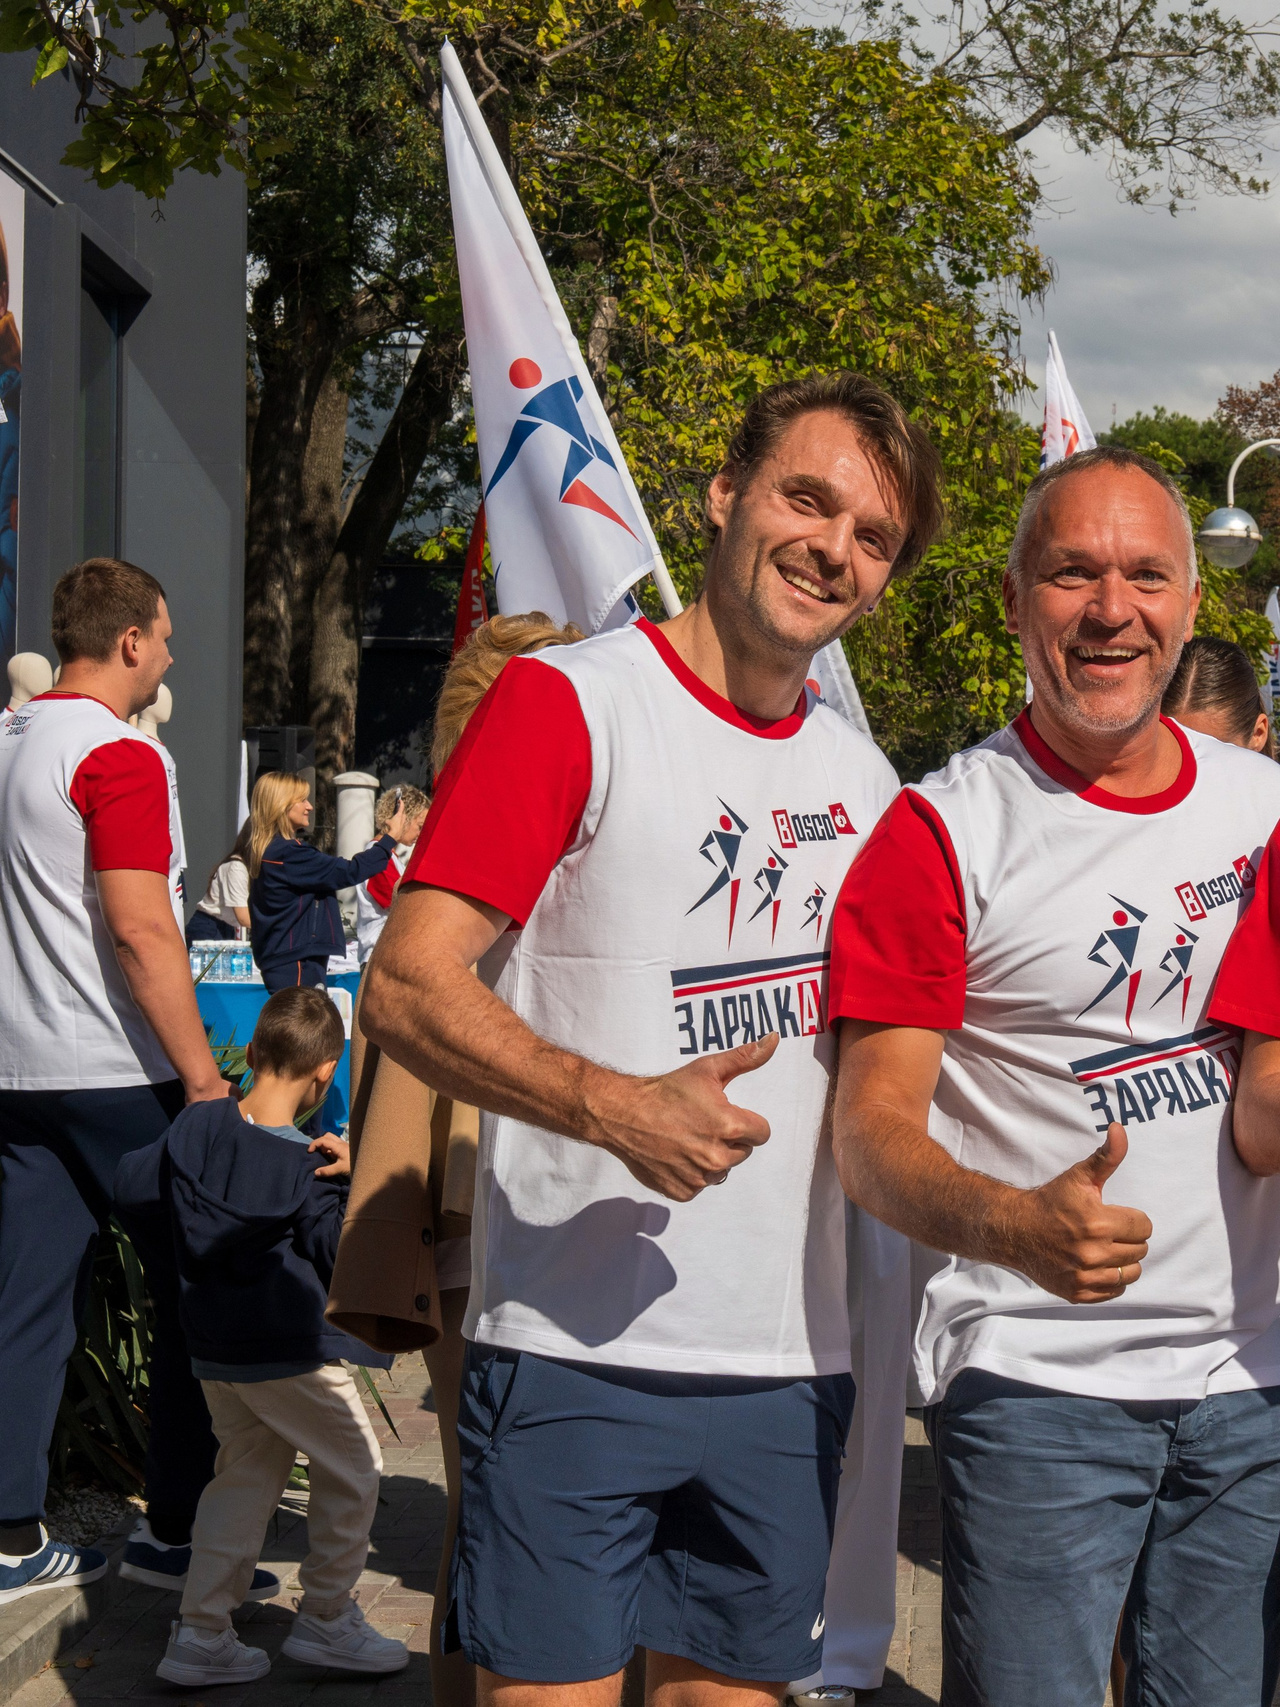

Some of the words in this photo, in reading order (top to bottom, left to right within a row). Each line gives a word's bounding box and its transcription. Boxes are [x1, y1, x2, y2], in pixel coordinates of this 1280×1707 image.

[772, 809, 837, 848] BOSCO
[1174, 871, 1245, 922] BOSCO
[675, 979, 825, 1055] ЗАРЯДКА
